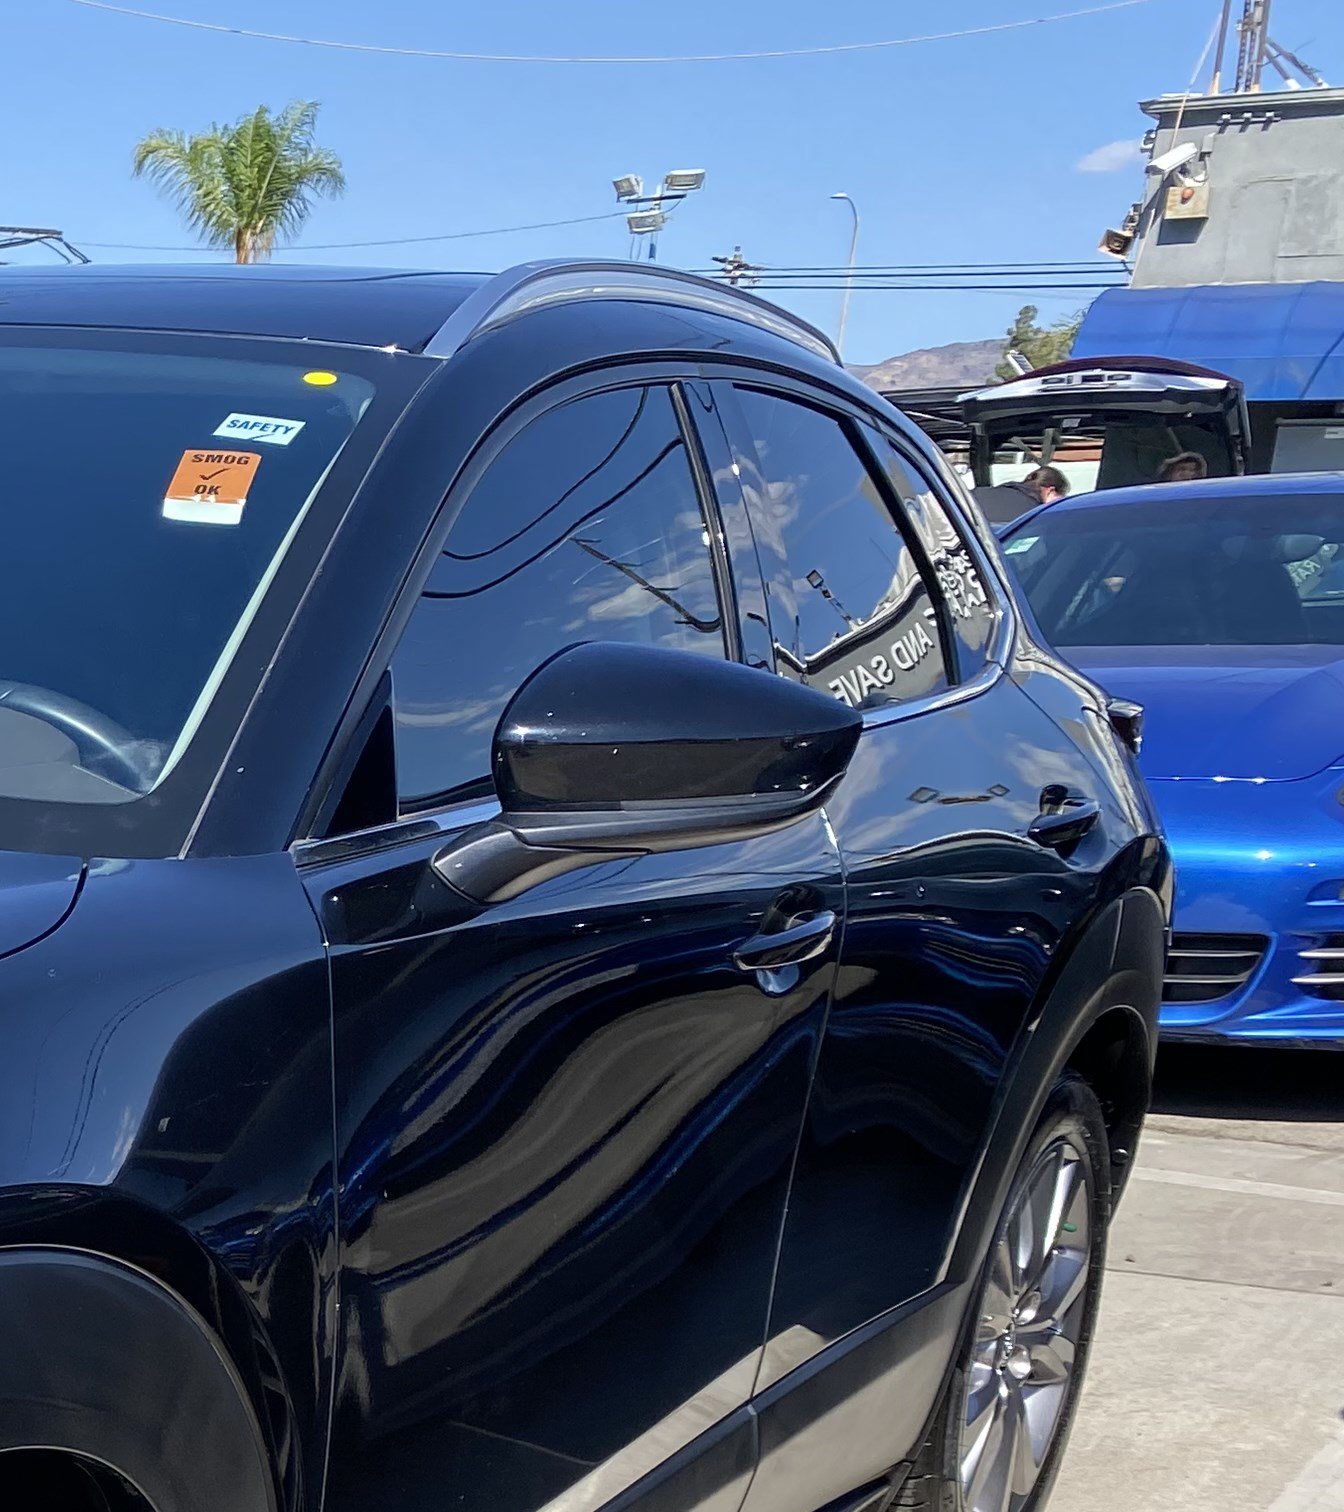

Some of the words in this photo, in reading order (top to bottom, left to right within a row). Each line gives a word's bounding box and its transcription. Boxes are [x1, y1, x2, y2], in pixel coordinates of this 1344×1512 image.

[226, 419, 296, 435] SAFETY
[191, 453, 251, 465] SMOG
[193, 484, 222, 496] OK
